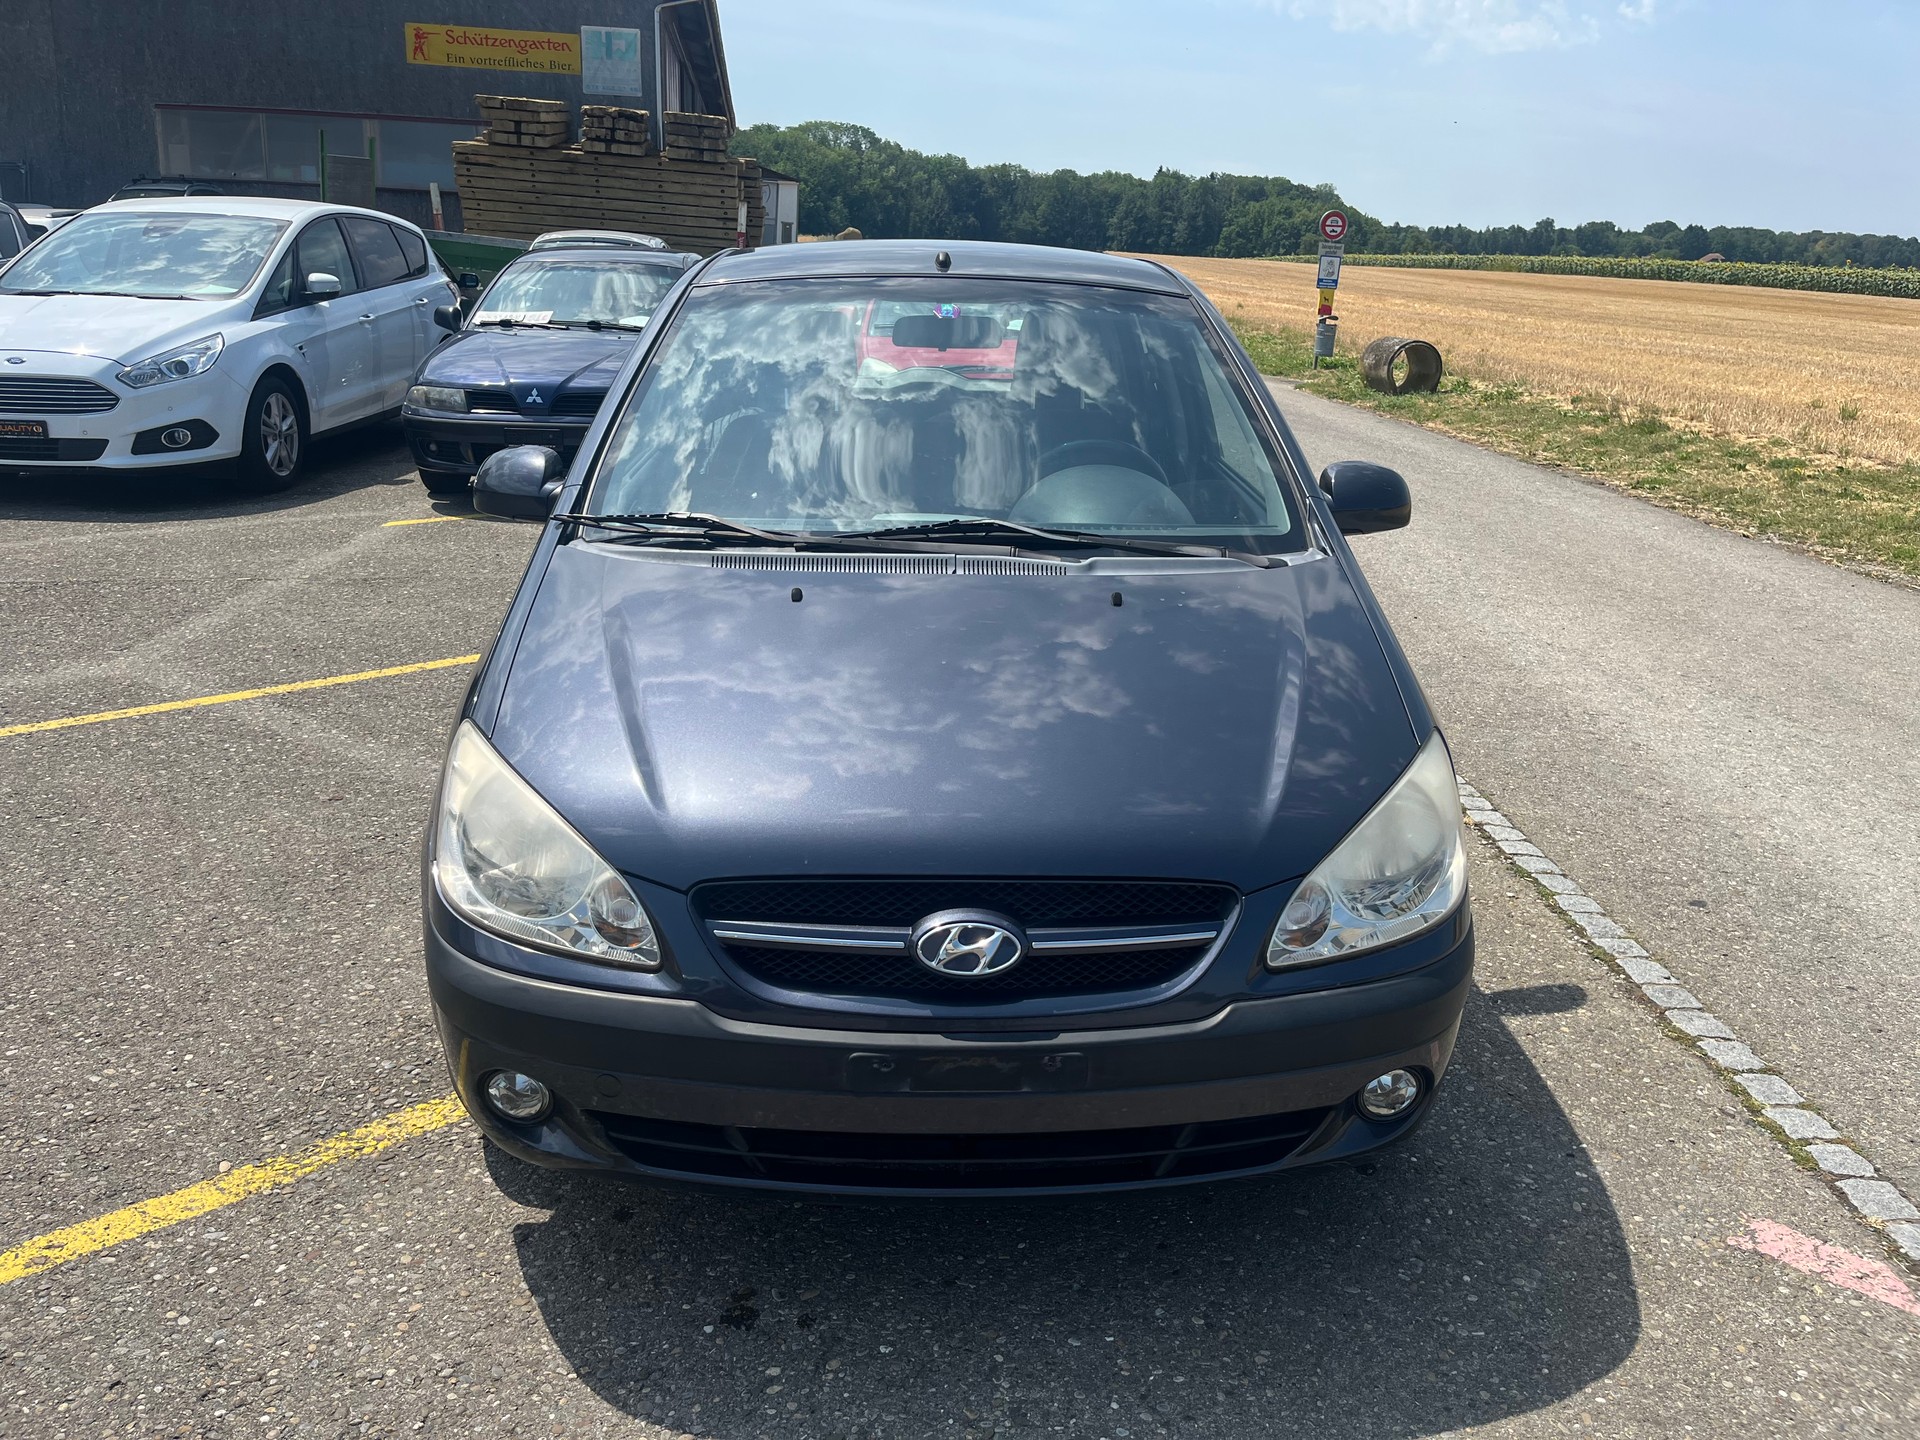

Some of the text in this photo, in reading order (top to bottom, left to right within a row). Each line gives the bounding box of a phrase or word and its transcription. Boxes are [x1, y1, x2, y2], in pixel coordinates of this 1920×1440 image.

[445, 29, 572, 55] Schützengarten
[446, 53, 465, 64] Ein
[469, 56, 545, 69] vortreffliches
[549, 60, 575, 71] Bier.
